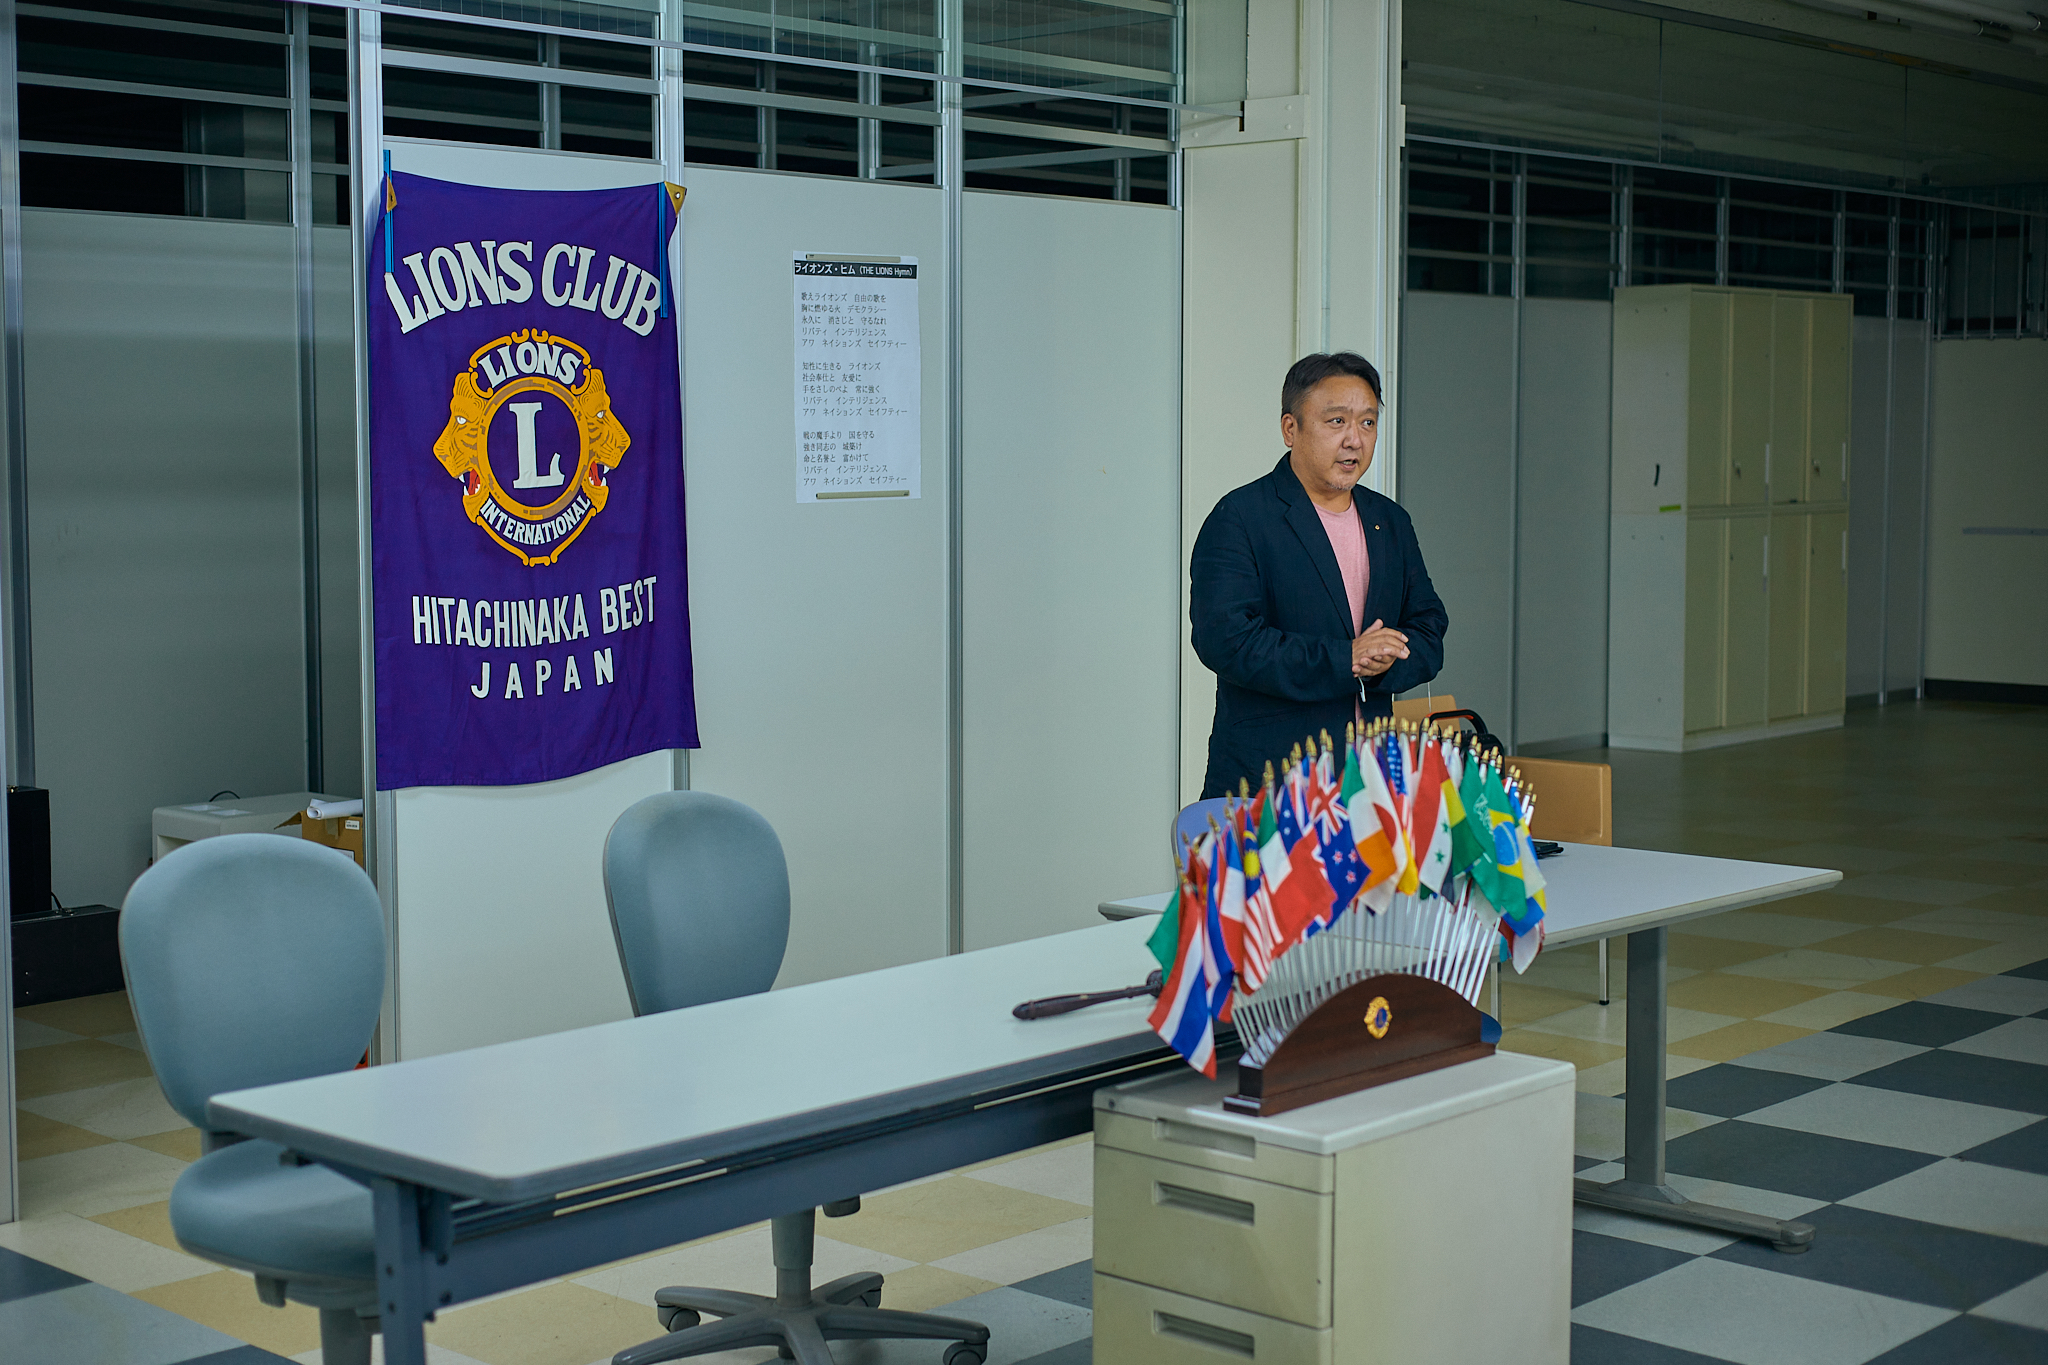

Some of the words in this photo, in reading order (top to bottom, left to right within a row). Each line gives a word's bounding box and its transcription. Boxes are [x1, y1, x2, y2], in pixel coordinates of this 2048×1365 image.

[795, 263, 855, 275] ライオンズ・ヒム
[876, 267, 892, 275] LIONS
[384, 240, 534, 334] LIONS
[541, 243, 661, 336] CLUB
[801, 291, 848, 302] 歌えライオンズ
[854, 293, 887, 303] 自由の歌を
[801, 303, 841, 313] 胸に燃ゆる火
[847, 304, 887, 314] デモクラシー
[801, 315, 821, 325] 永久に
[802, 326, 827, 336] リバティ
[834, 327, 887, 337] インテリジェンス
[801, 338, 815, 347] アワ
[822, 338, 862, 348] ネイションズ
[867, 339, 907, 348] セイフティー
[478, 341, 581, 388] LIONS
[802, 361, 842, 371] 知性に生きる
[848, 361, 881, 371] ライオンズ
[802, 373, 835, 383] 社会奉仕と
[841, 373, 862, 383] 友愛に
[802, 384, 849, 394] 手をさしのべよ
[854, 384, 880, 394] 常に強く
[803, 396, 828, 405] リバティ
[835, 396, 888, 405] インテリジェンス
[802, 408, 816, 417] アワ
[822, 407, 863, 417] ネイションズ
[867, 407, 908, 416] セイフティー
[848, 430, 875, 440] 国を守る
[509, 402, 565, 489] L
[803, 442, 837, 452] 強き同志の
[803, 453, 836, 463] 命と名誉と
[804, 466, 829, 475] リバティ
[836, 464, 888, 474] インテリジェンス
[803, 477, 817, 486] アワ
[823, 475, 863, 486] ネイションズ
[868, 475, 907, 485] セイフティー
[479, 496, 592, 545] INTERNATIONAL
[413, 593, 589, 648] HITACHINAKA
[600, 576, 657, 635] BEST
[470, 648, 614, 700] JAPAN
